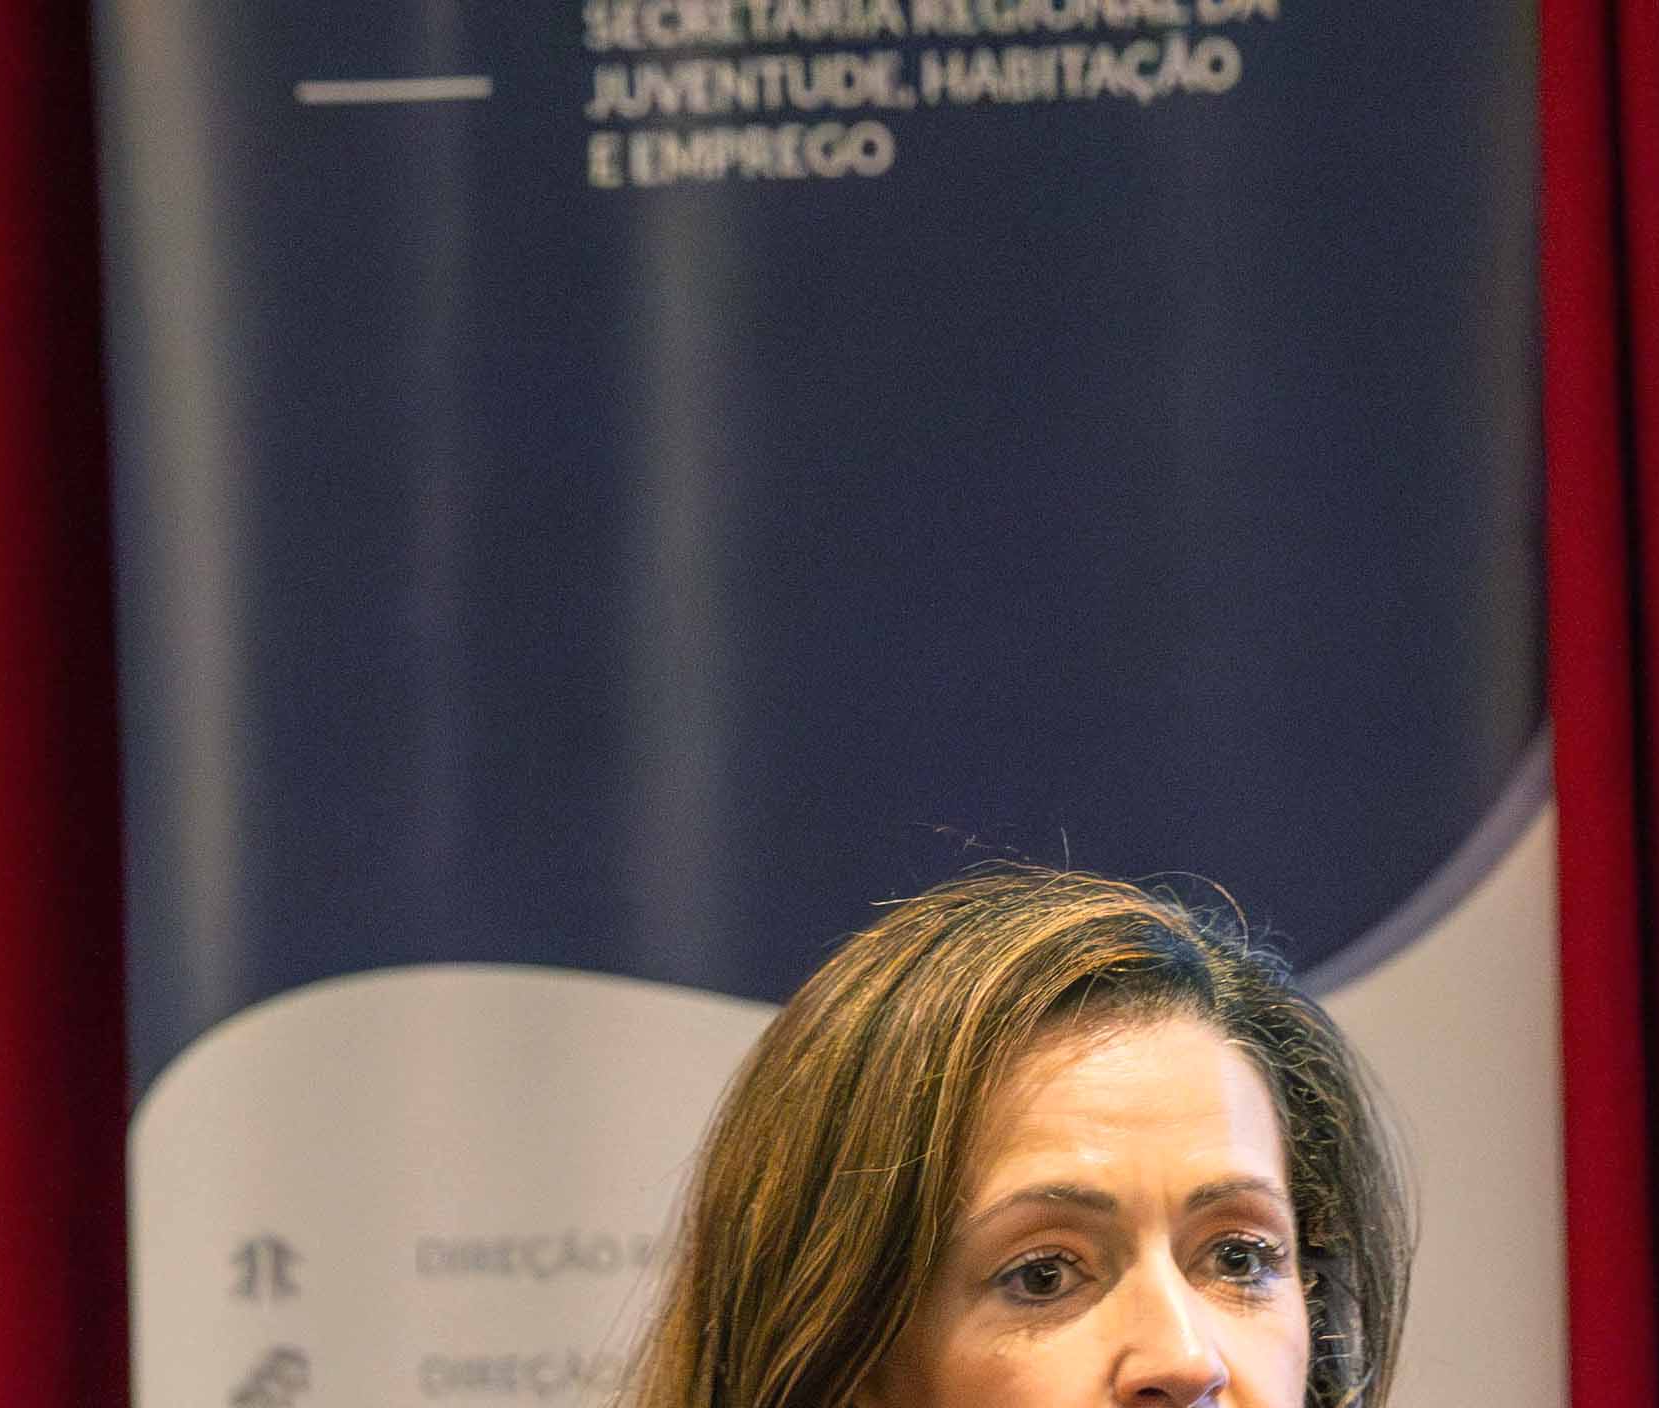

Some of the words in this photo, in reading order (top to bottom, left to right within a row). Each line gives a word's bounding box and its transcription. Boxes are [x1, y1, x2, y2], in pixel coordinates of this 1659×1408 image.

[921, 33, 1241, 106] HABITAÇÃO
[587, 130, 624, 187] E
[629, 120, 894, 187] EMPREGO
[415, 1227, 624, 1280] DIREÇÃO
